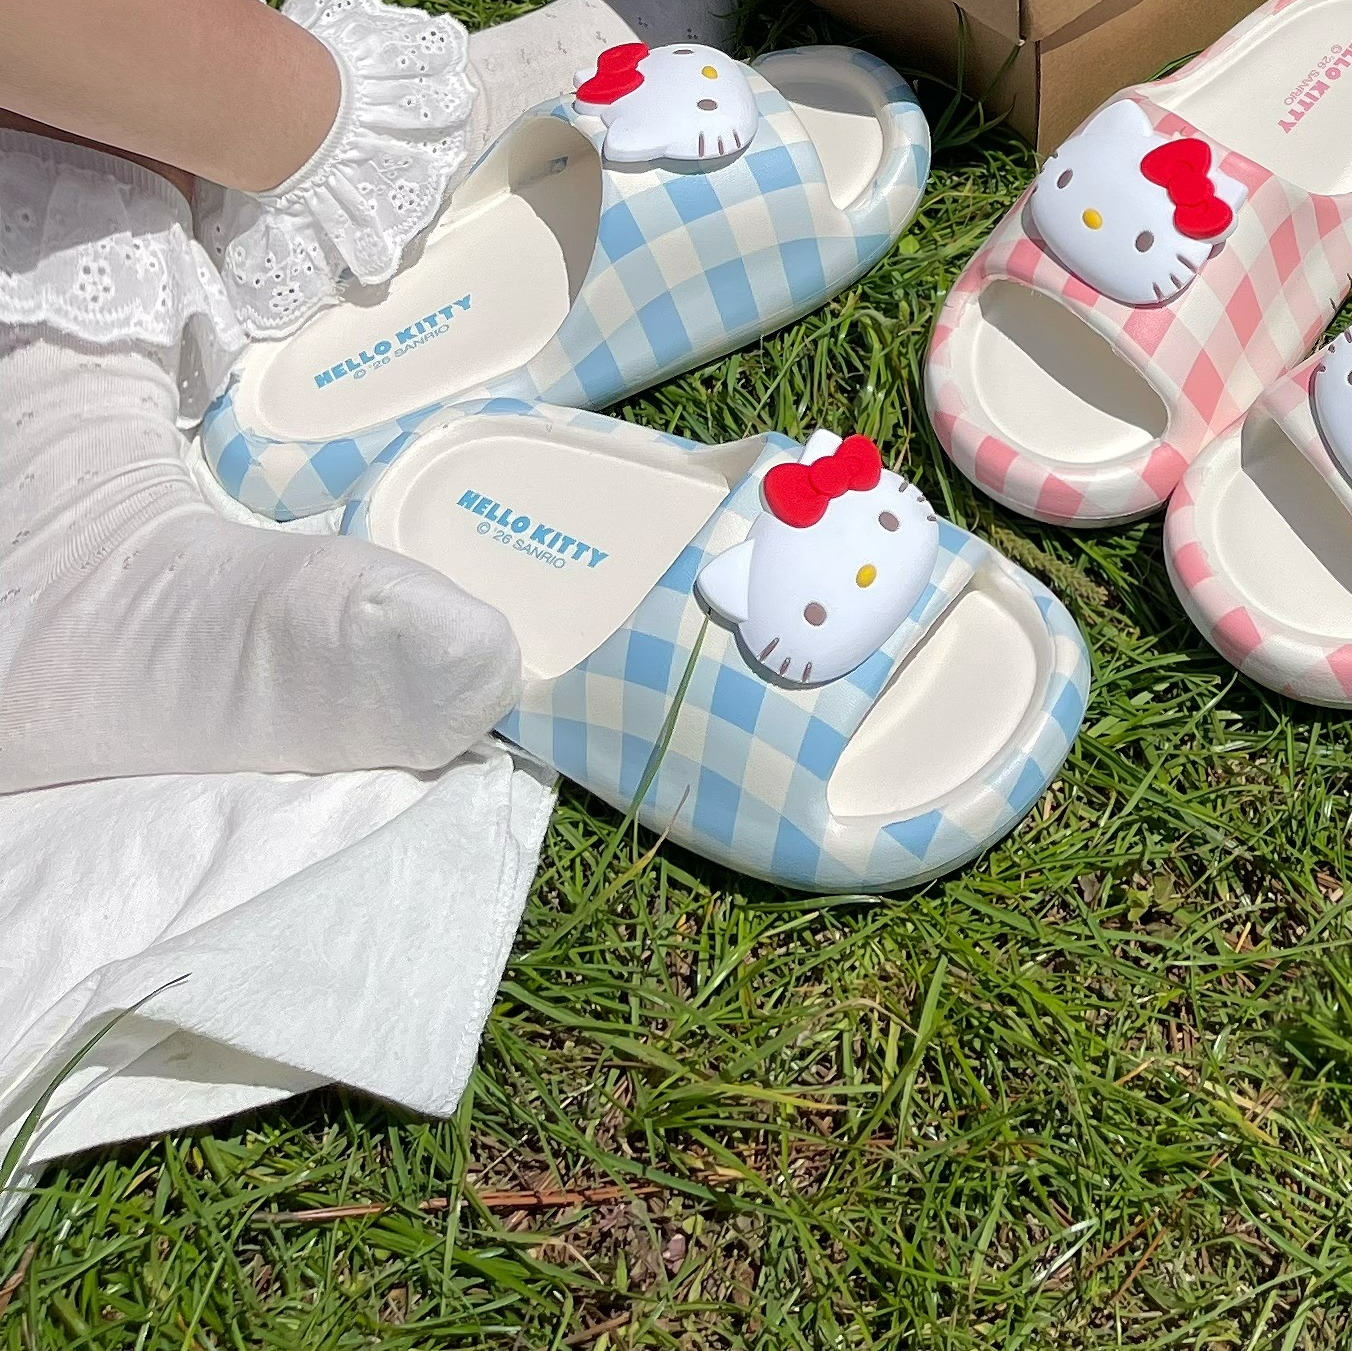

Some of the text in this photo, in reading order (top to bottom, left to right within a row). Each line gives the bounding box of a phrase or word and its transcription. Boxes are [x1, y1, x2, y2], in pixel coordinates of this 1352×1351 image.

[1277, 79, 1330, 134] KITTY
[1283, 69, 1320, 106] SANRIO
[314, 294, 471, 389] HELLO KITTY
[394, 324, 450, 358] SANRIO
[456, 489, 609, 568] HELLO KITTY
[512, 538, 566, 569] SANRIO
